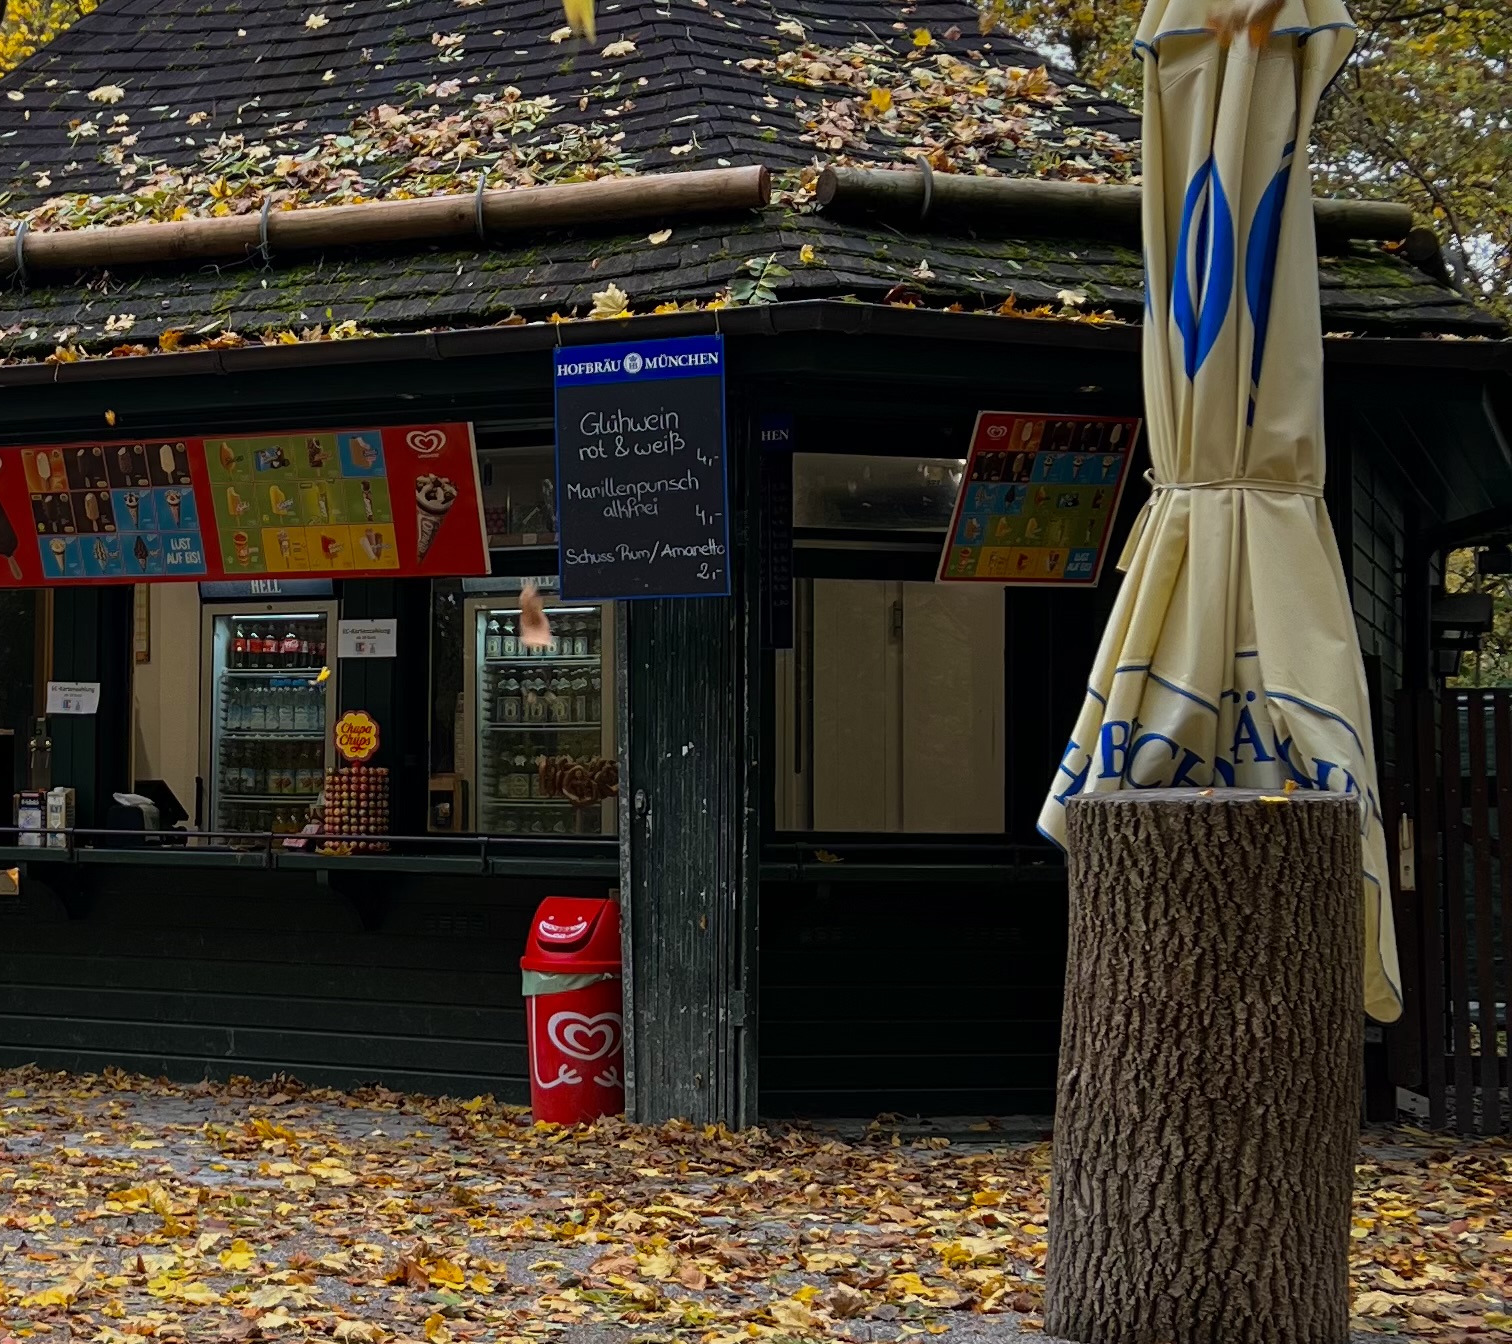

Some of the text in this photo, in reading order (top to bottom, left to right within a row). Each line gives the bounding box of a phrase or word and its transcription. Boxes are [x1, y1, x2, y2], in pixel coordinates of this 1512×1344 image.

[557, 359, 621, 376] HOFBRÄU
[645, 352, 719, 369] MÜNCHEN
[580, 406, 679, 436] Glühwein
[579, 430, 686, 461] rot & weiß
[567, 469, 699, 501] Marillenpunsch
[603, 497, 658, 519] alkfrei
[170, 537, 191, 551] LUST
[167, 551, 182, 564] AUF
[565, 548, 615, 565] Schuss
[341, 723, 372, 735] Chupa
[340, 734, 370, 748] Chups
